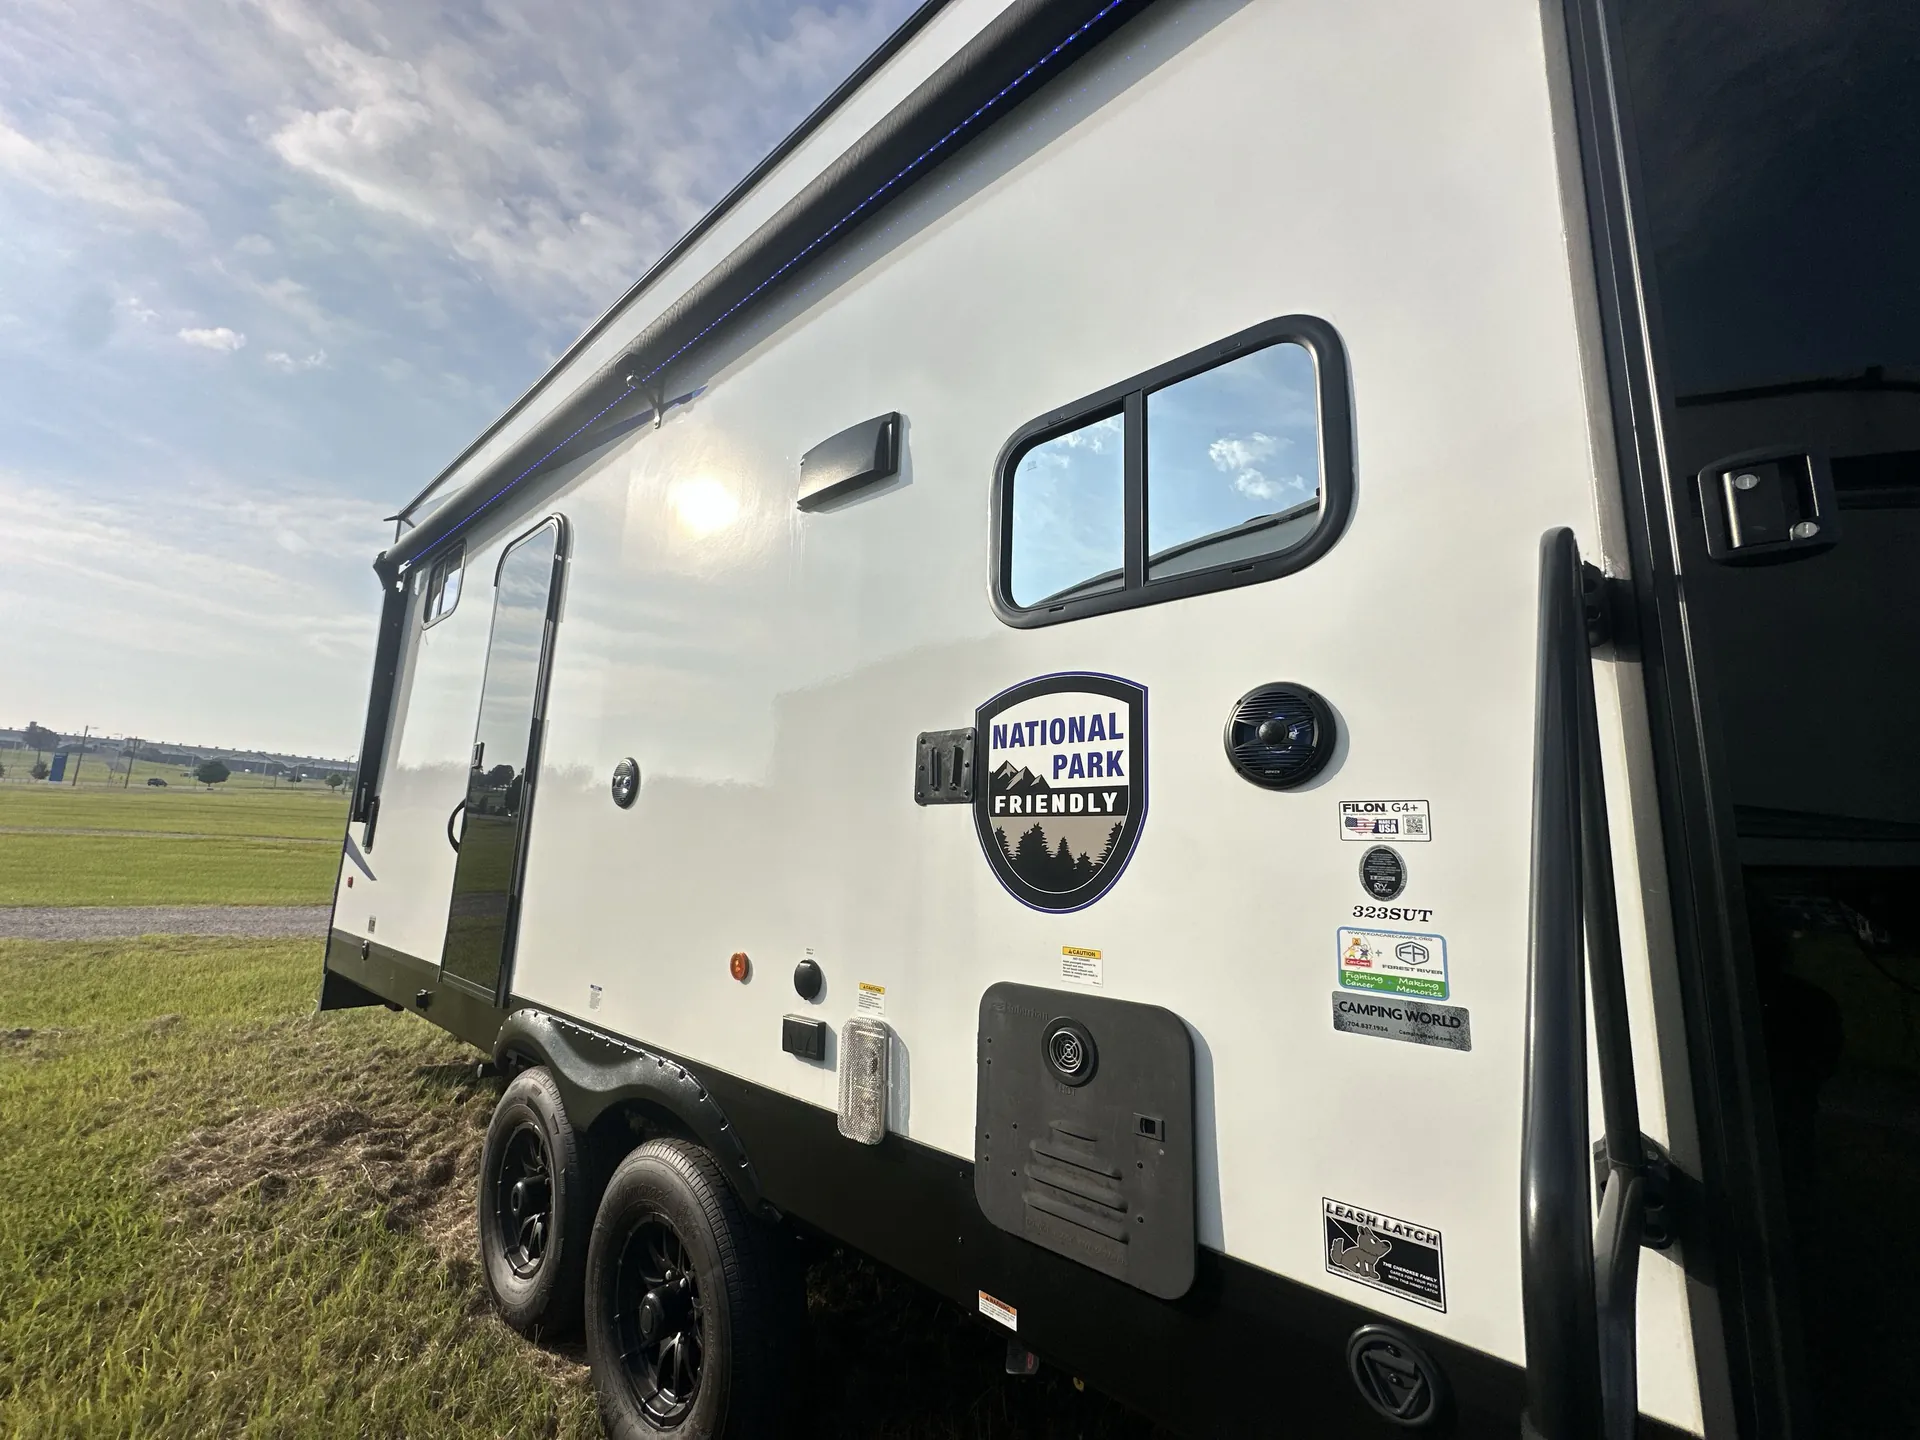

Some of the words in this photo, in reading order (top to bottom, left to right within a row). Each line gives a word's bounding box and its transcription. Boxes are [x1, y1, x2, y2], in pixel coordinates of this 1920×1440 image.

[992, 712, 1124, 749] NATIONAL
[1052, 750, 1125, 780] PARK
[994, 792, 1118, 814] FRIENDLY
[1391, 802, 1419, 812] G4+
[1378, 824, 1397, 833] USA
[1352, 905, 1433, 922] 323SUT
[1072, 949, 1096, 957] CAUTION
[1382, 964, 1416, 972] FOREST
[1345, 971, 1384, 984] Fighting
[1345, 979, 1375, 989] Cancer
[1398, 978, 1439, 991] Making
[1396, 985, 1443, 998] Memories
[1339, 1001, 1403, 1020] CAMPING
[1404, 1009, 1461, 1029] WORLD
[1326, 1203, 1377, 1227] LEASH
[1382, 1220, 1438, 1246] LATCH
[1382, 1261, 1392, 1269] THE
